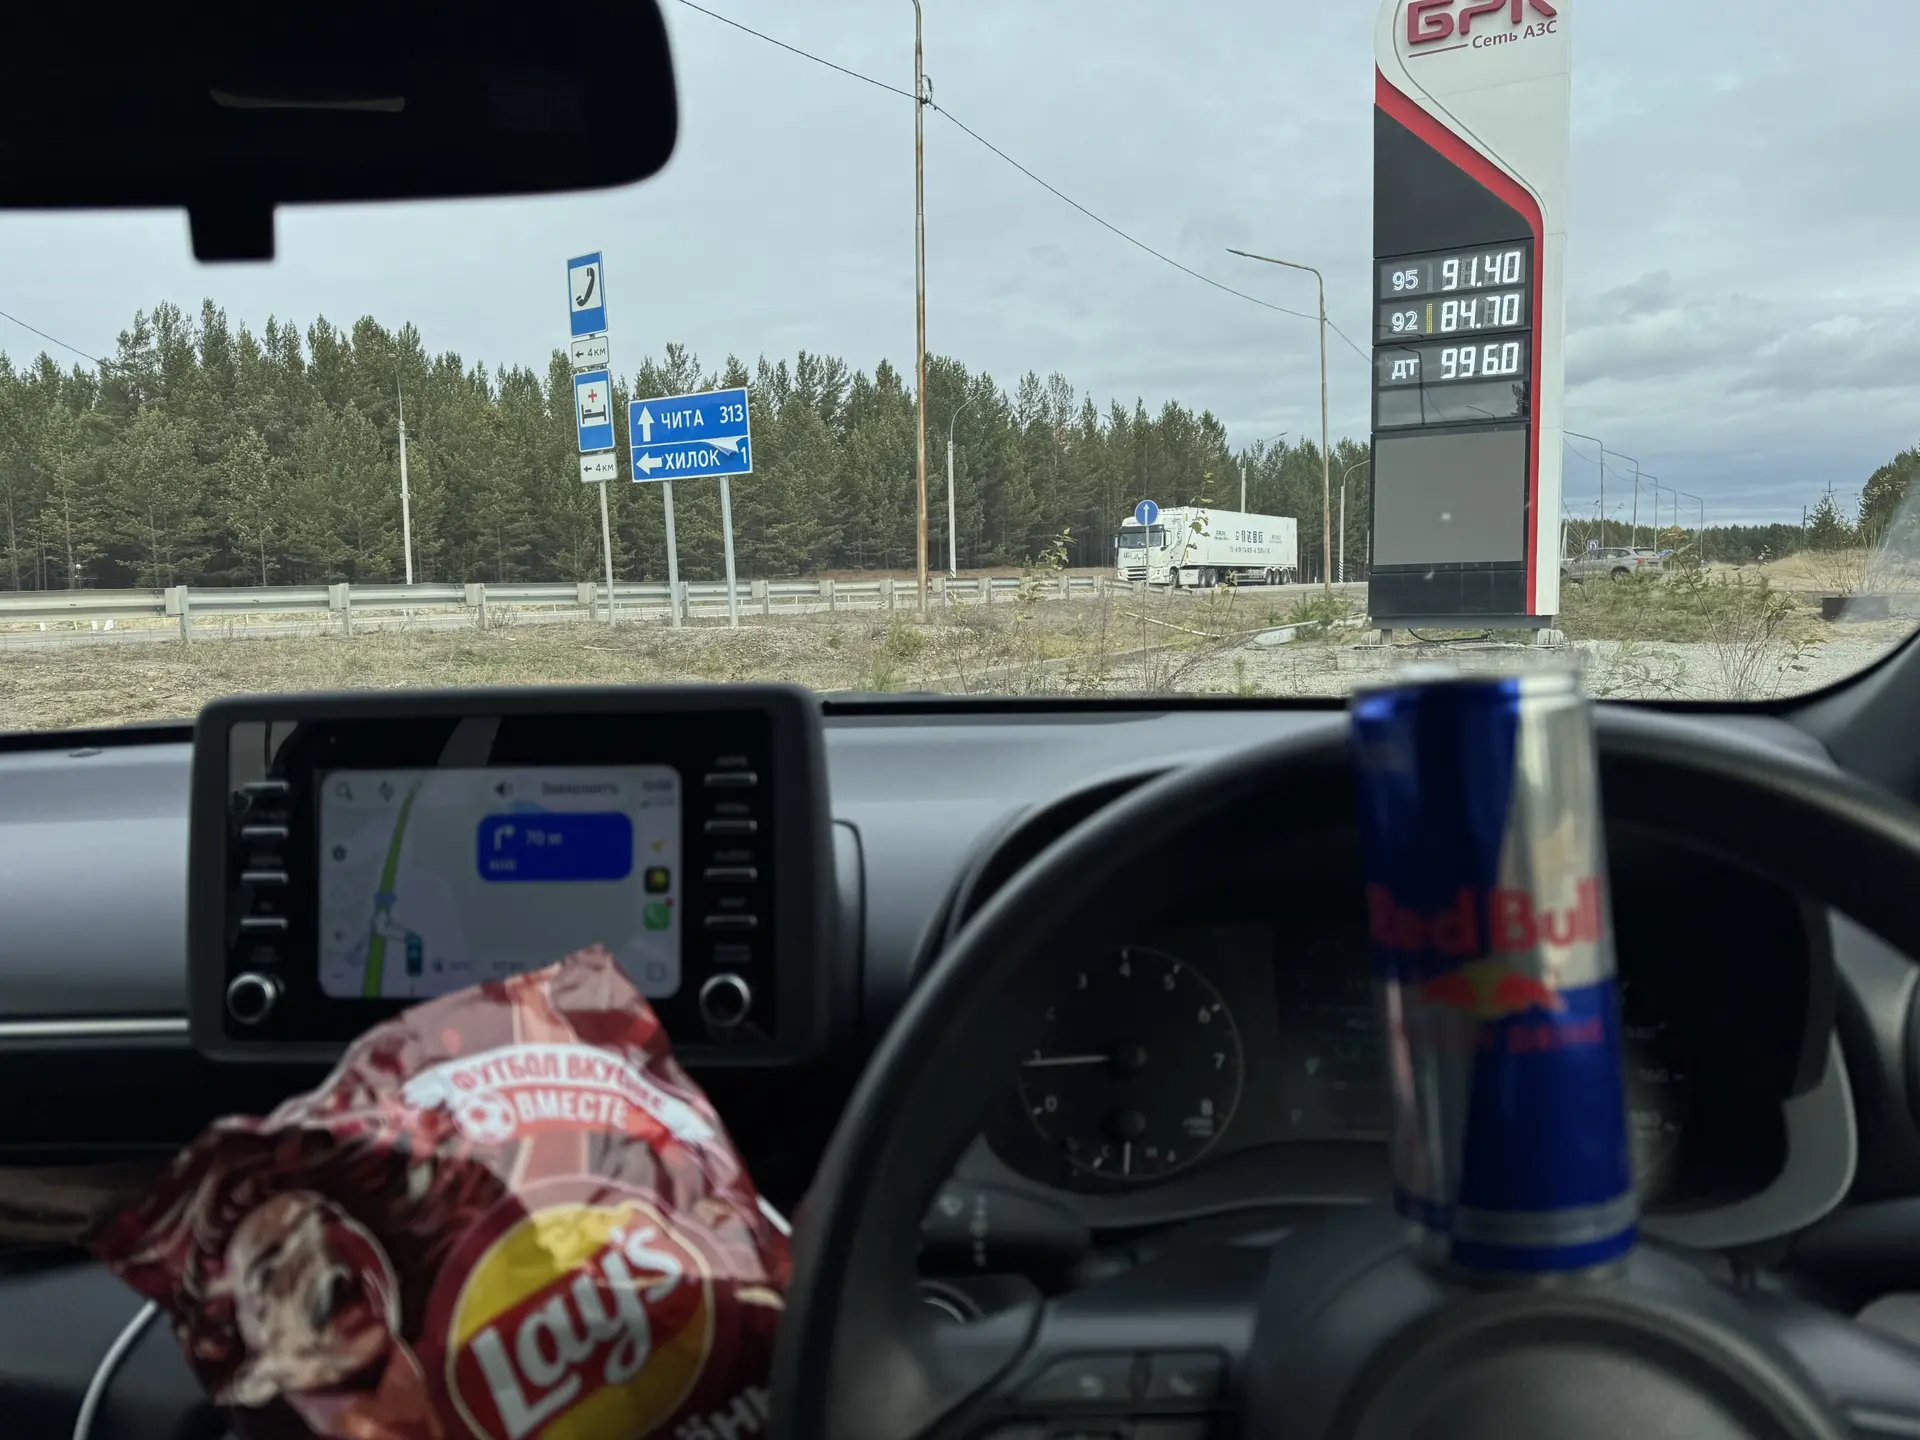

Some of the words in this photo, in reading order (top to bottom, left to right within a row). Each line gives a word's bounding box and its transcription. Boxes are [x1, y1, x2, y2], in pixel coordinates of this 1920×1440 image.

[1472, 33, 1518, 49] Сеть
[1522, 20, 1557, 39] АЗС
[1392, 269, 1419, 291] 95
[1441, 251, 1521, 291] 91.40
[1392, 310, 1418, 332] 92
[1440, 293, 1520, 332] 84.70
[1391, 358, 1419, 380] ДТ
[661, 409, 704, 429] ЧИТА
[719, 404, 744, 424] 313
[664, 449, 720, 470] ХИЛОК
[740, 446, 747, 464] 1
[1490, 878, 1602, 949] Bull
[451, 1052, 560, 1091] ФУТБОЛ
[513, 1090, 629, 1130] ВМЕСТЕ
[468, 1225, 683, 1440] Lay's
